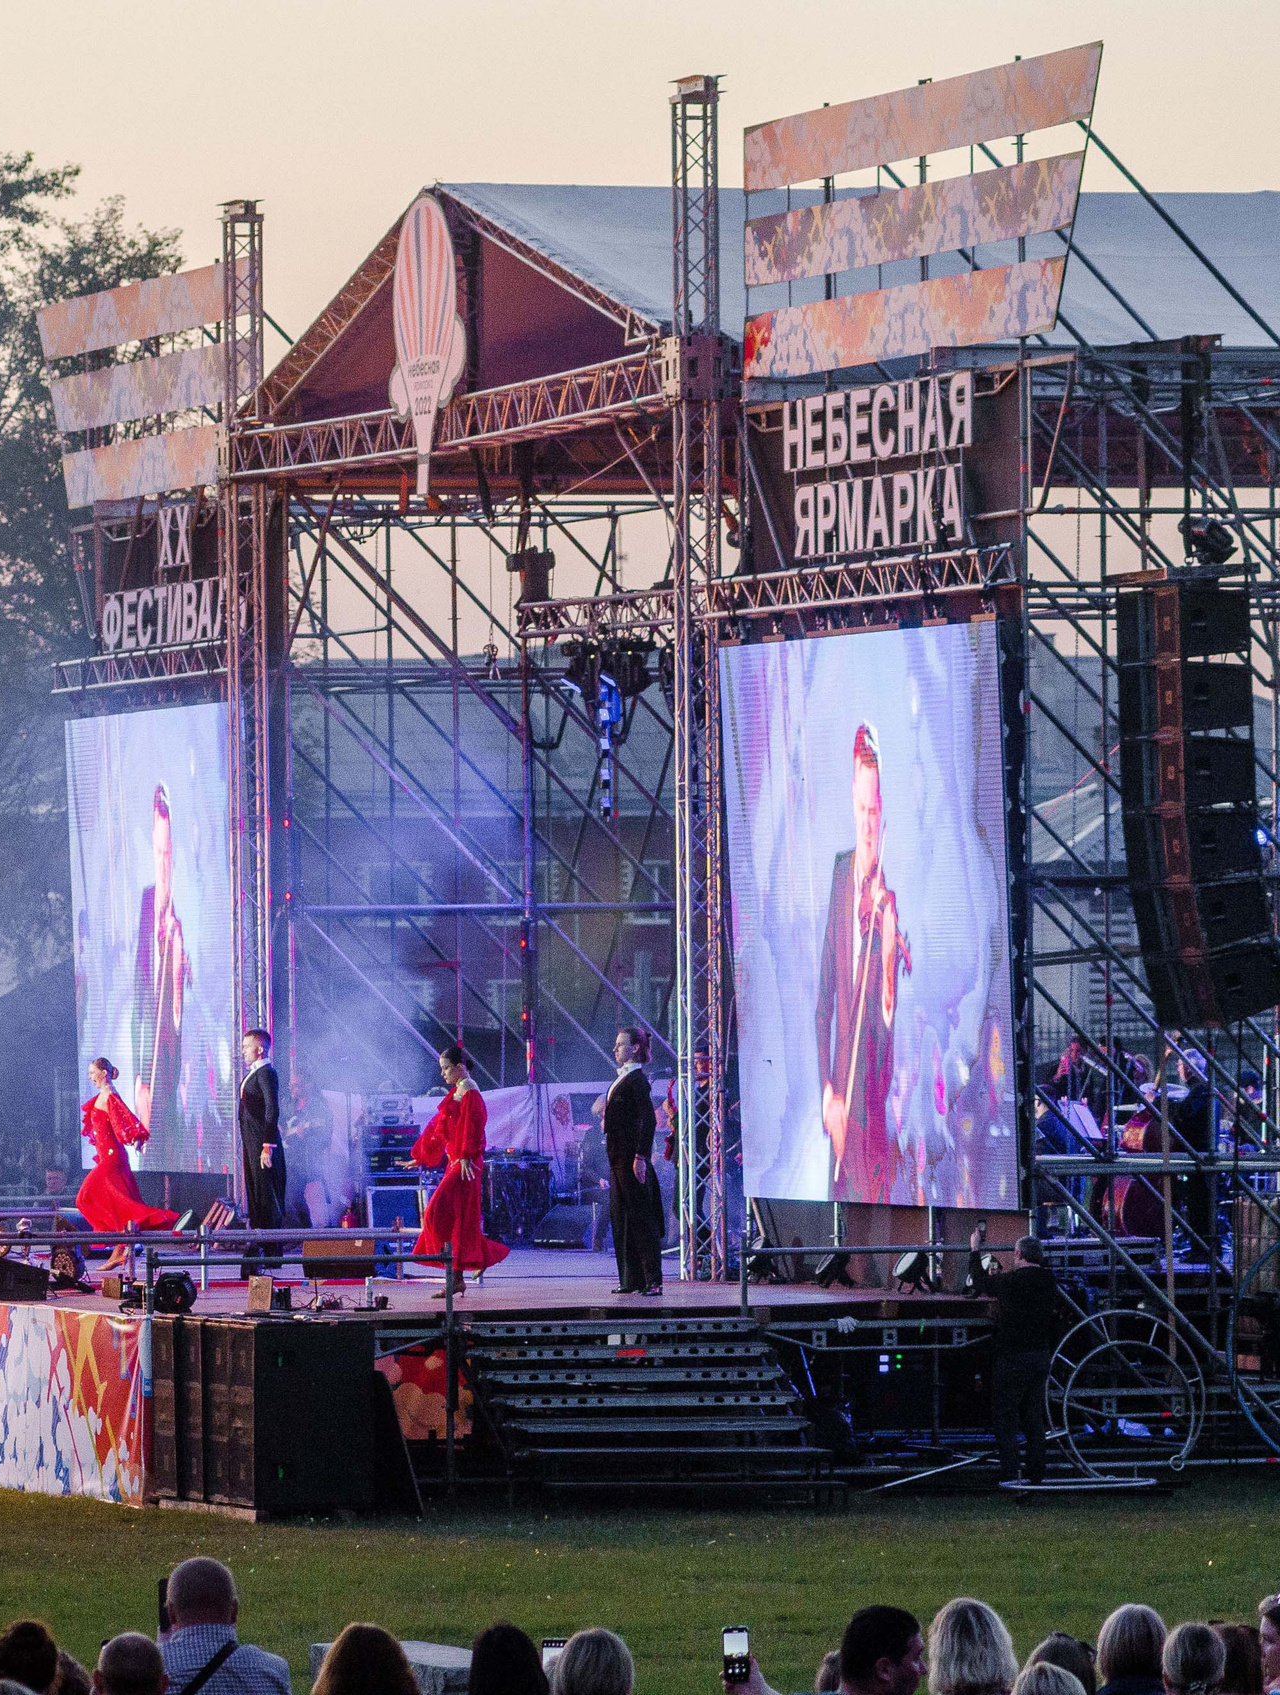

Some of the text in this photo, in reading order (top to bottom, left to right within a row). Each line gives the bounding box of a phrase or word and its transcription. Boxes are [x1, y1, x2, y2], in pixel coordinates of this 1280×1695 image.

[414, 396, 432, 416] 2022
[783, 371, 972, 472] НЕБЕСНАЯ
[794, 465, 963, 558] ЯРМАРКА
